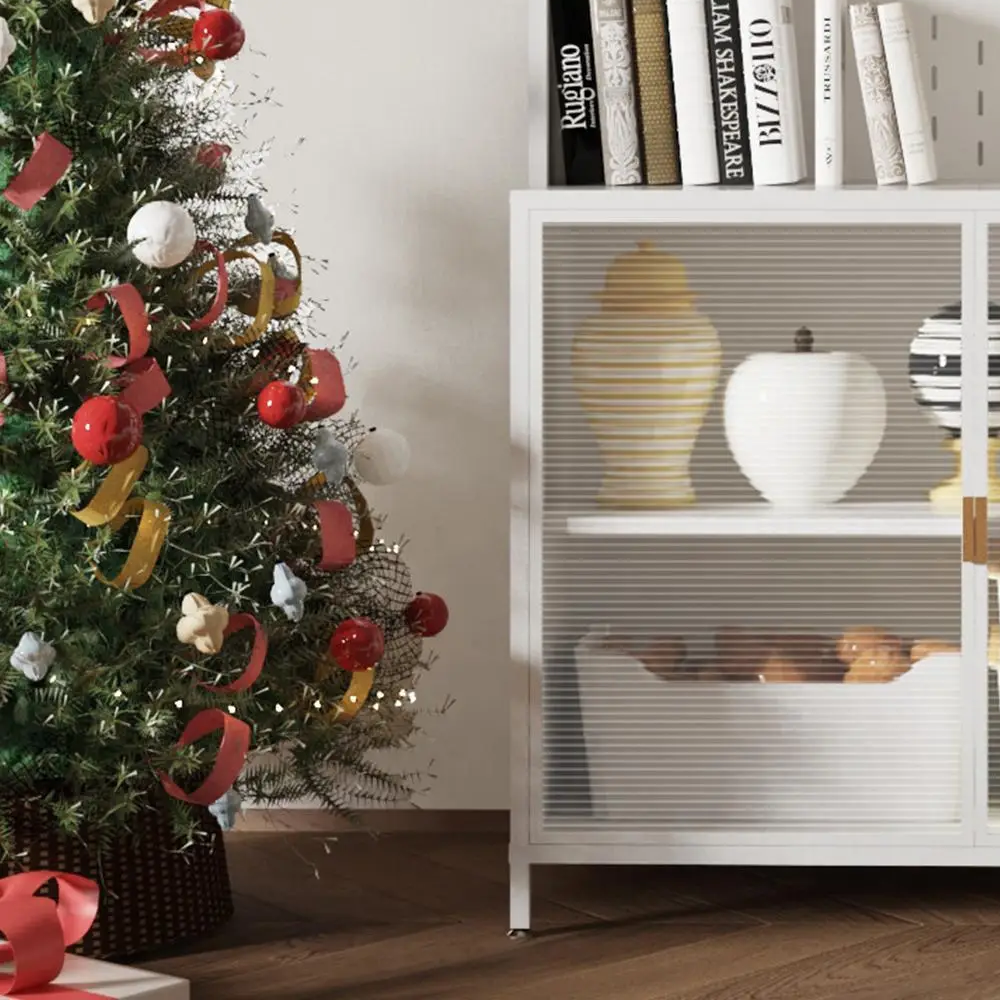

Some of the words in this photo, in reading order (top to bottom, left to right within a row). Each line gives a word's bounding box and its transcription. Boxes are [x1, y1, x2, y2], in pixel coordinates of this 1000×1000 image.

[558, 43, 595, 130] Rugiano
[823, 16, 832, 103] TRUSSARDI
[714, 47, 745, 179] SHAKESPEARE
